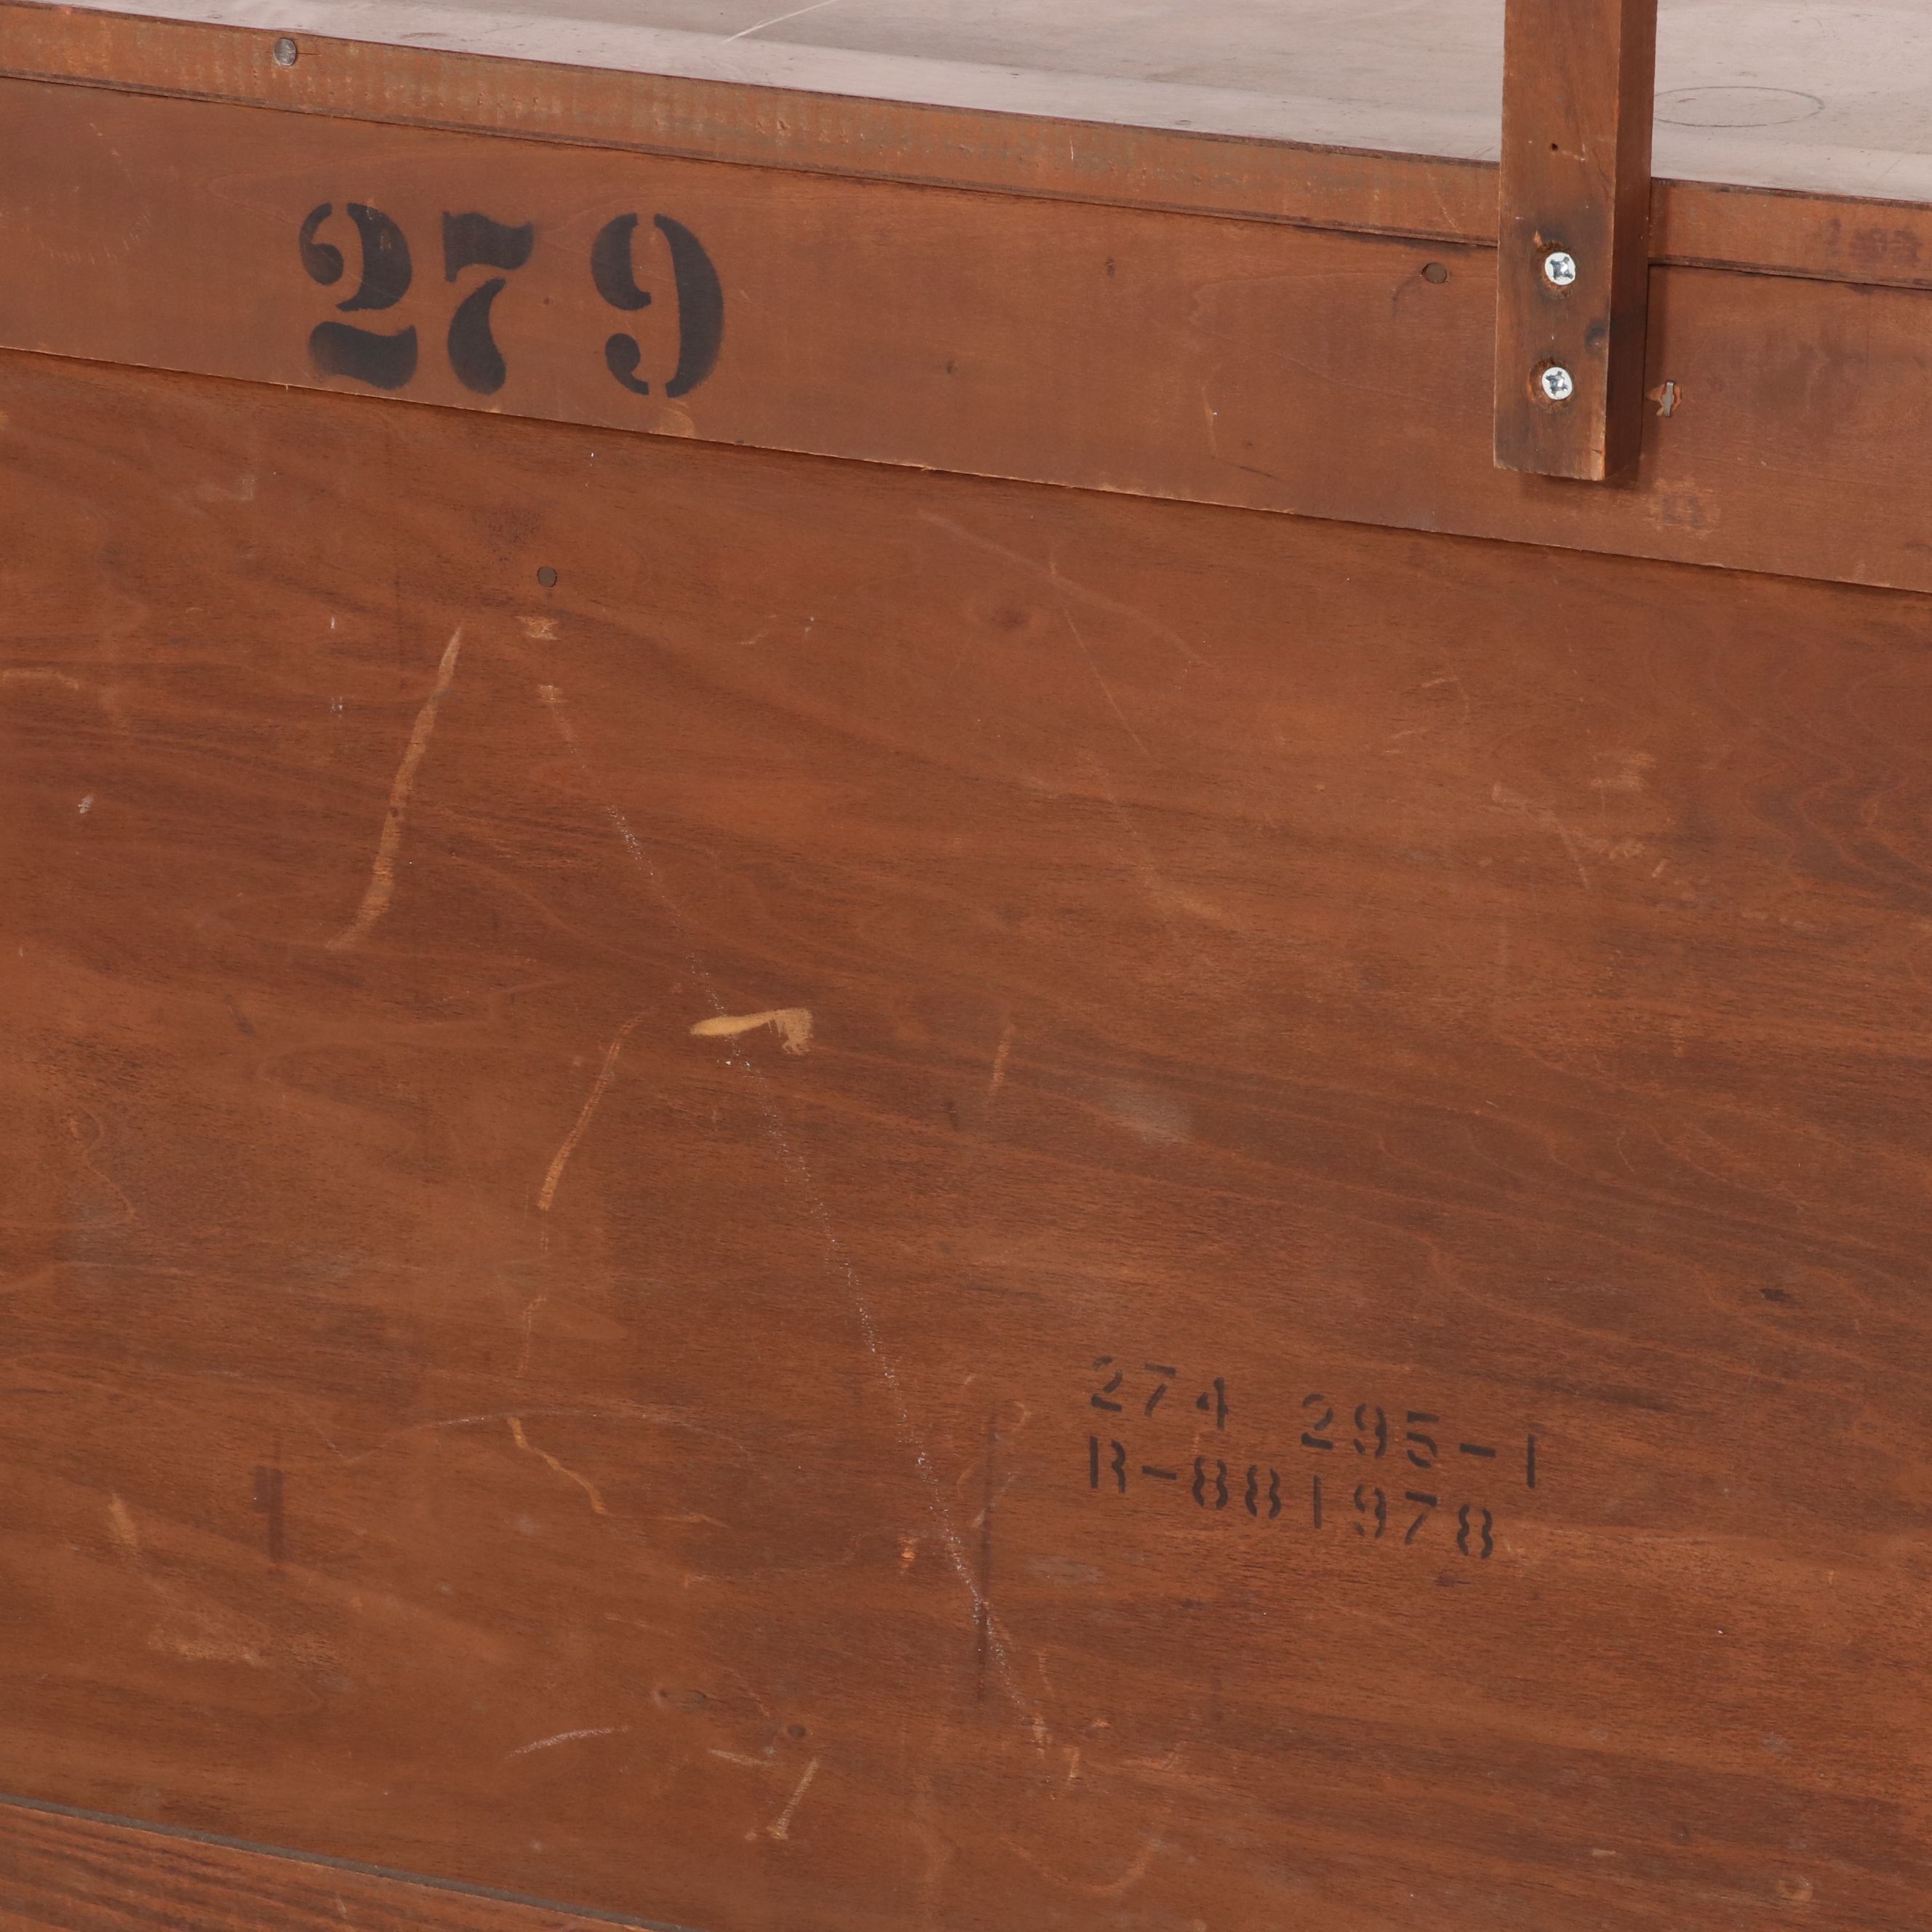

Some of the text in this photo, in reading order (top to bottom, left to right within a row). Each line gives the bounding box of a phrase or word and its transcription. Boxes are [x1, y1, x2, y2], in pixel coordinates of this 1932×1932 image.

[298, 201, 724, 399] 279
[1091, 1356, 1536, 1489] 274 295-1
